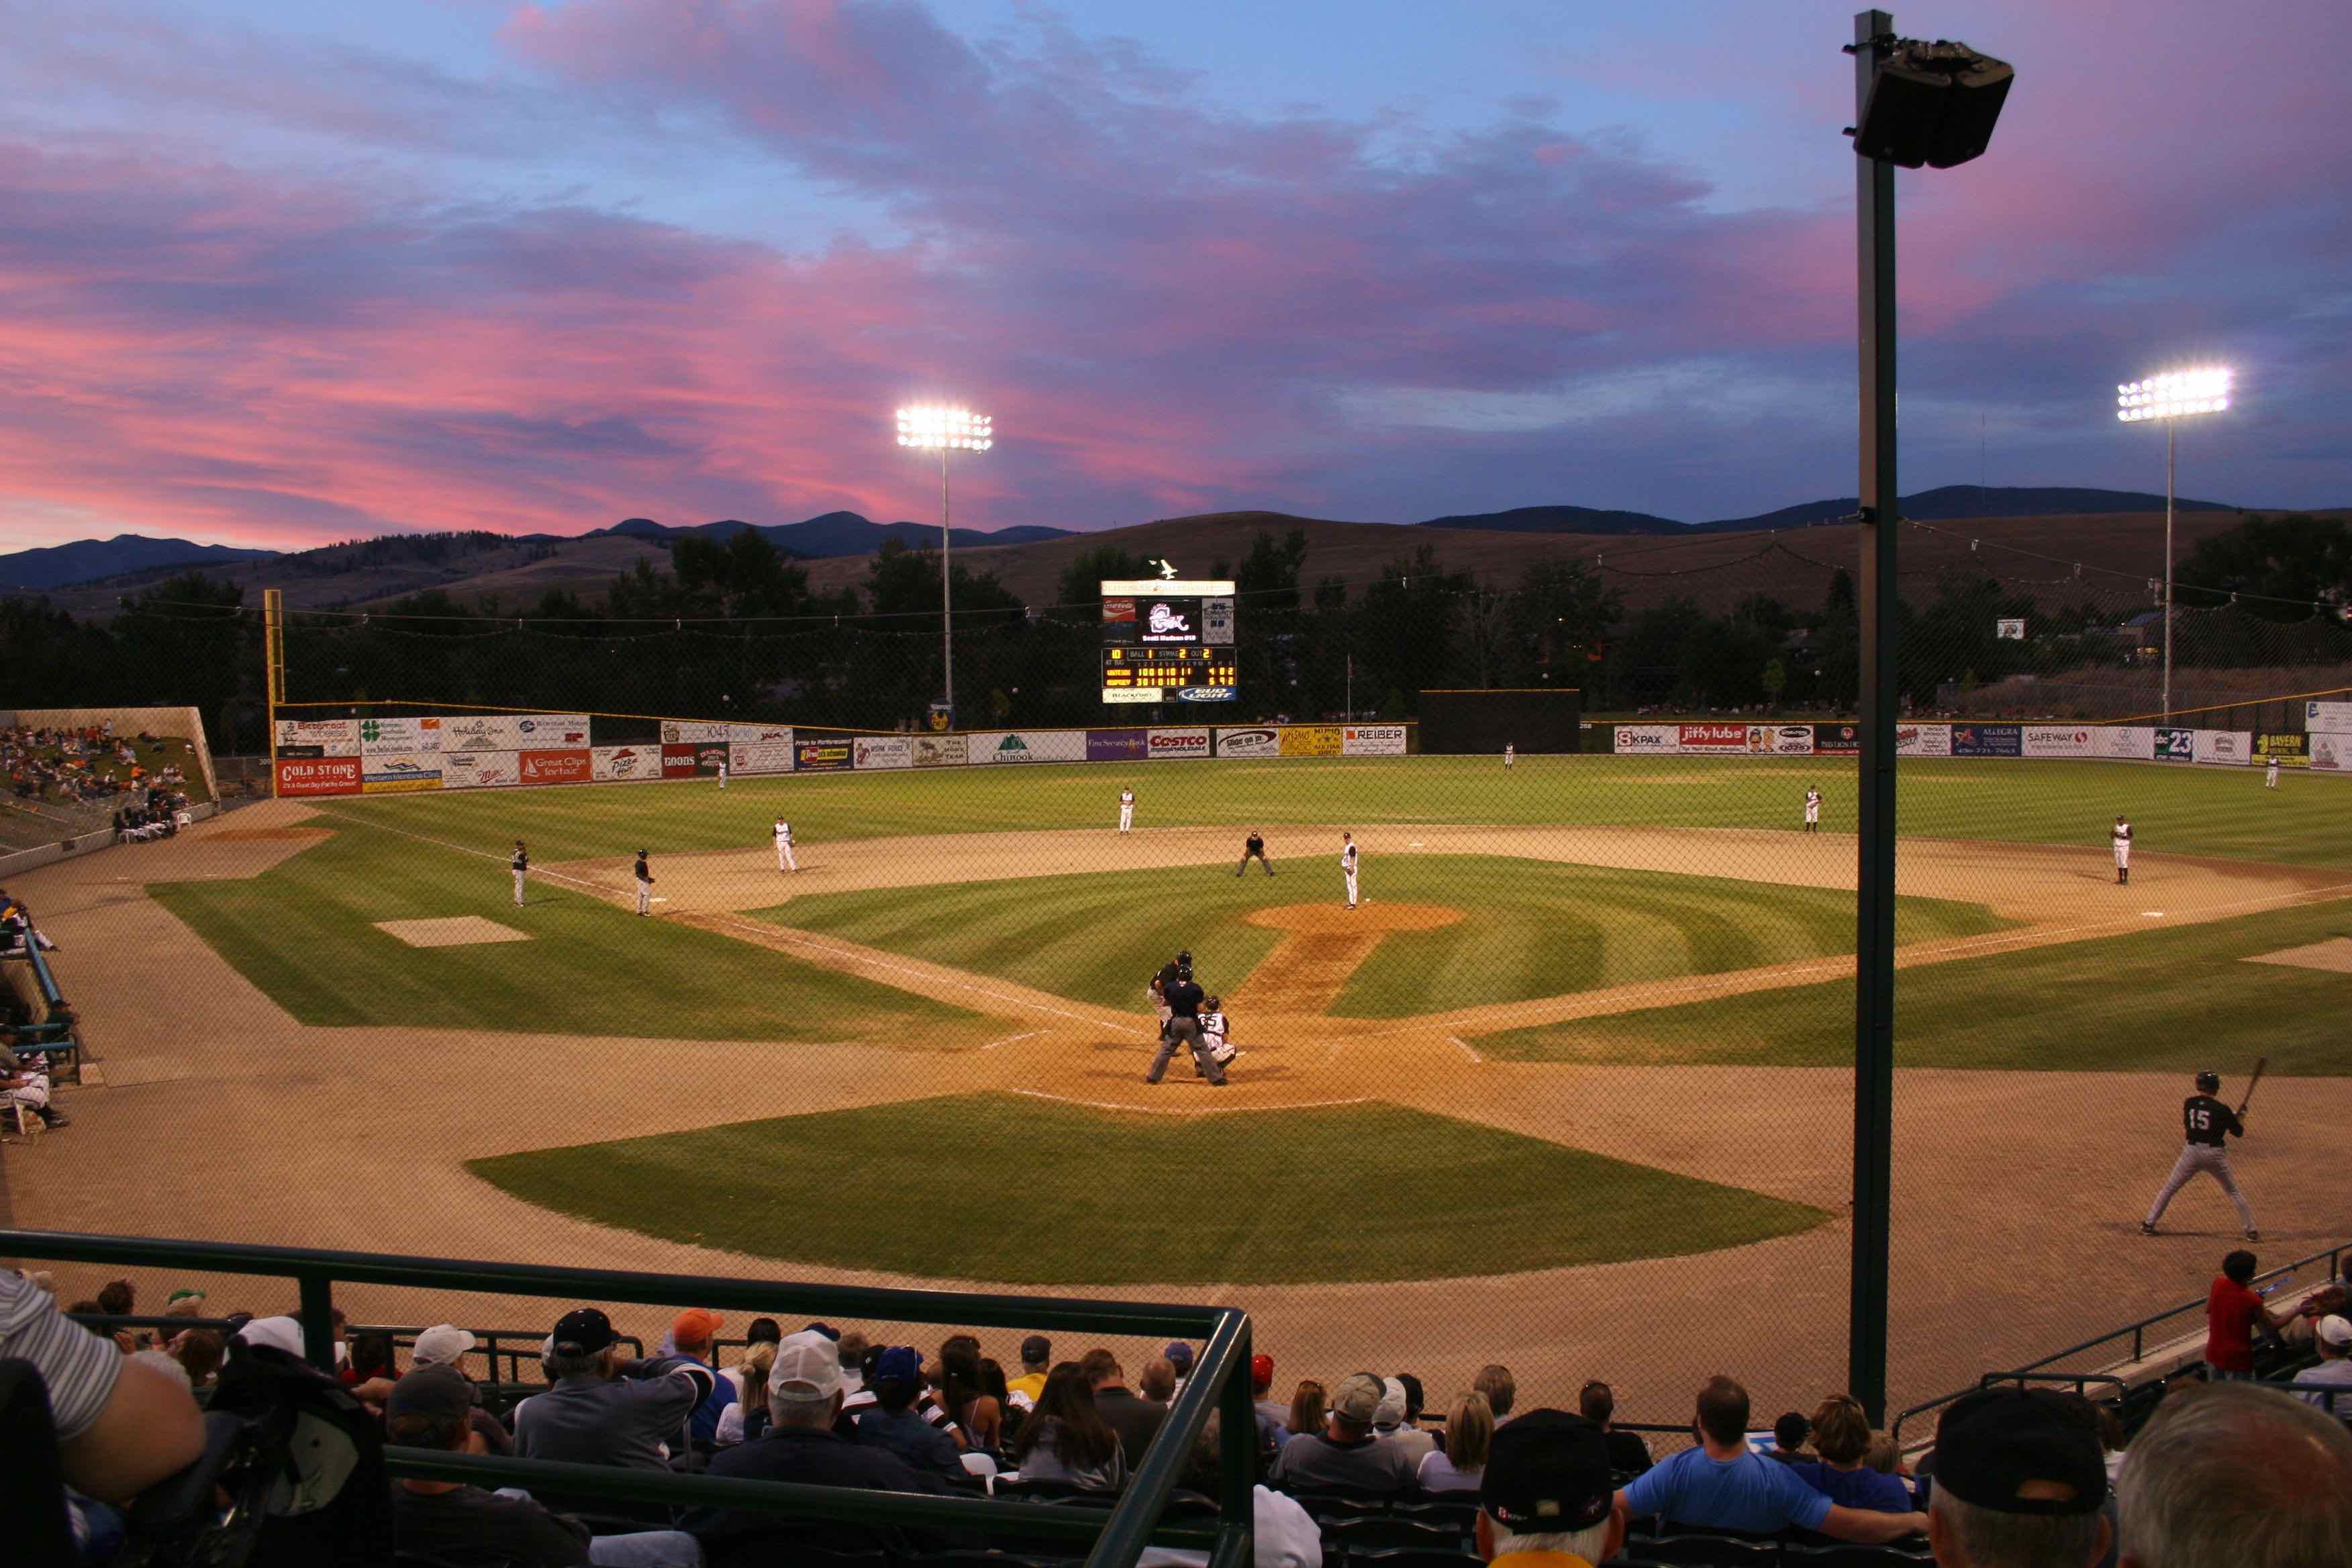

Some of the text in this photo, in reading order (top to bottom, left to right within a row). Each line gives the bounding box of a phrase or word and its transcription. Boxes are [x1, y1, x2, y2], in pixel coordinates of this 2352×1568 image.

[1112, 649, 1121, 659] 10
[1179, 649, 1185, 658] 2
[1203, 648, 1210, 658] 2
[1142, 668, 1148, 676] 0
[1149, 668, 1155, 676] 0
[1157, 668, 1163, 676] 0
[1170, 668, 1176, 676] 0
[1228, 668, 1233, 676] 2
[452, 726, 504, 737] Holiday Inn
[1358, 730, 1402, 740] REIBER
[1681, 726, 1741, 741] jiffy lube
[1150, 735, 1208, 746] COSTCO
[1632, 736, 1661, 744] KPAX
[2028, 733, 2073, 742] SAFEWAY
[2155, 734, 2169, 744] abc
[2169, 731, 2192, 753] 23
[2270, 735, 2302, 747] BAYERN
[1103, 740, 1128, 748] Security
[993, 752, 1033, 762] Chinook
[536, 757, 586, 768] Great Clips
[611, 758, 638, 773] Pizza
[283, 765, 355, 781] COLD STONE
[545, 767, 580, 776] for hair
[617, 767, 634, 776] Hut
[2189, 1108, 2210, 1130] 15
